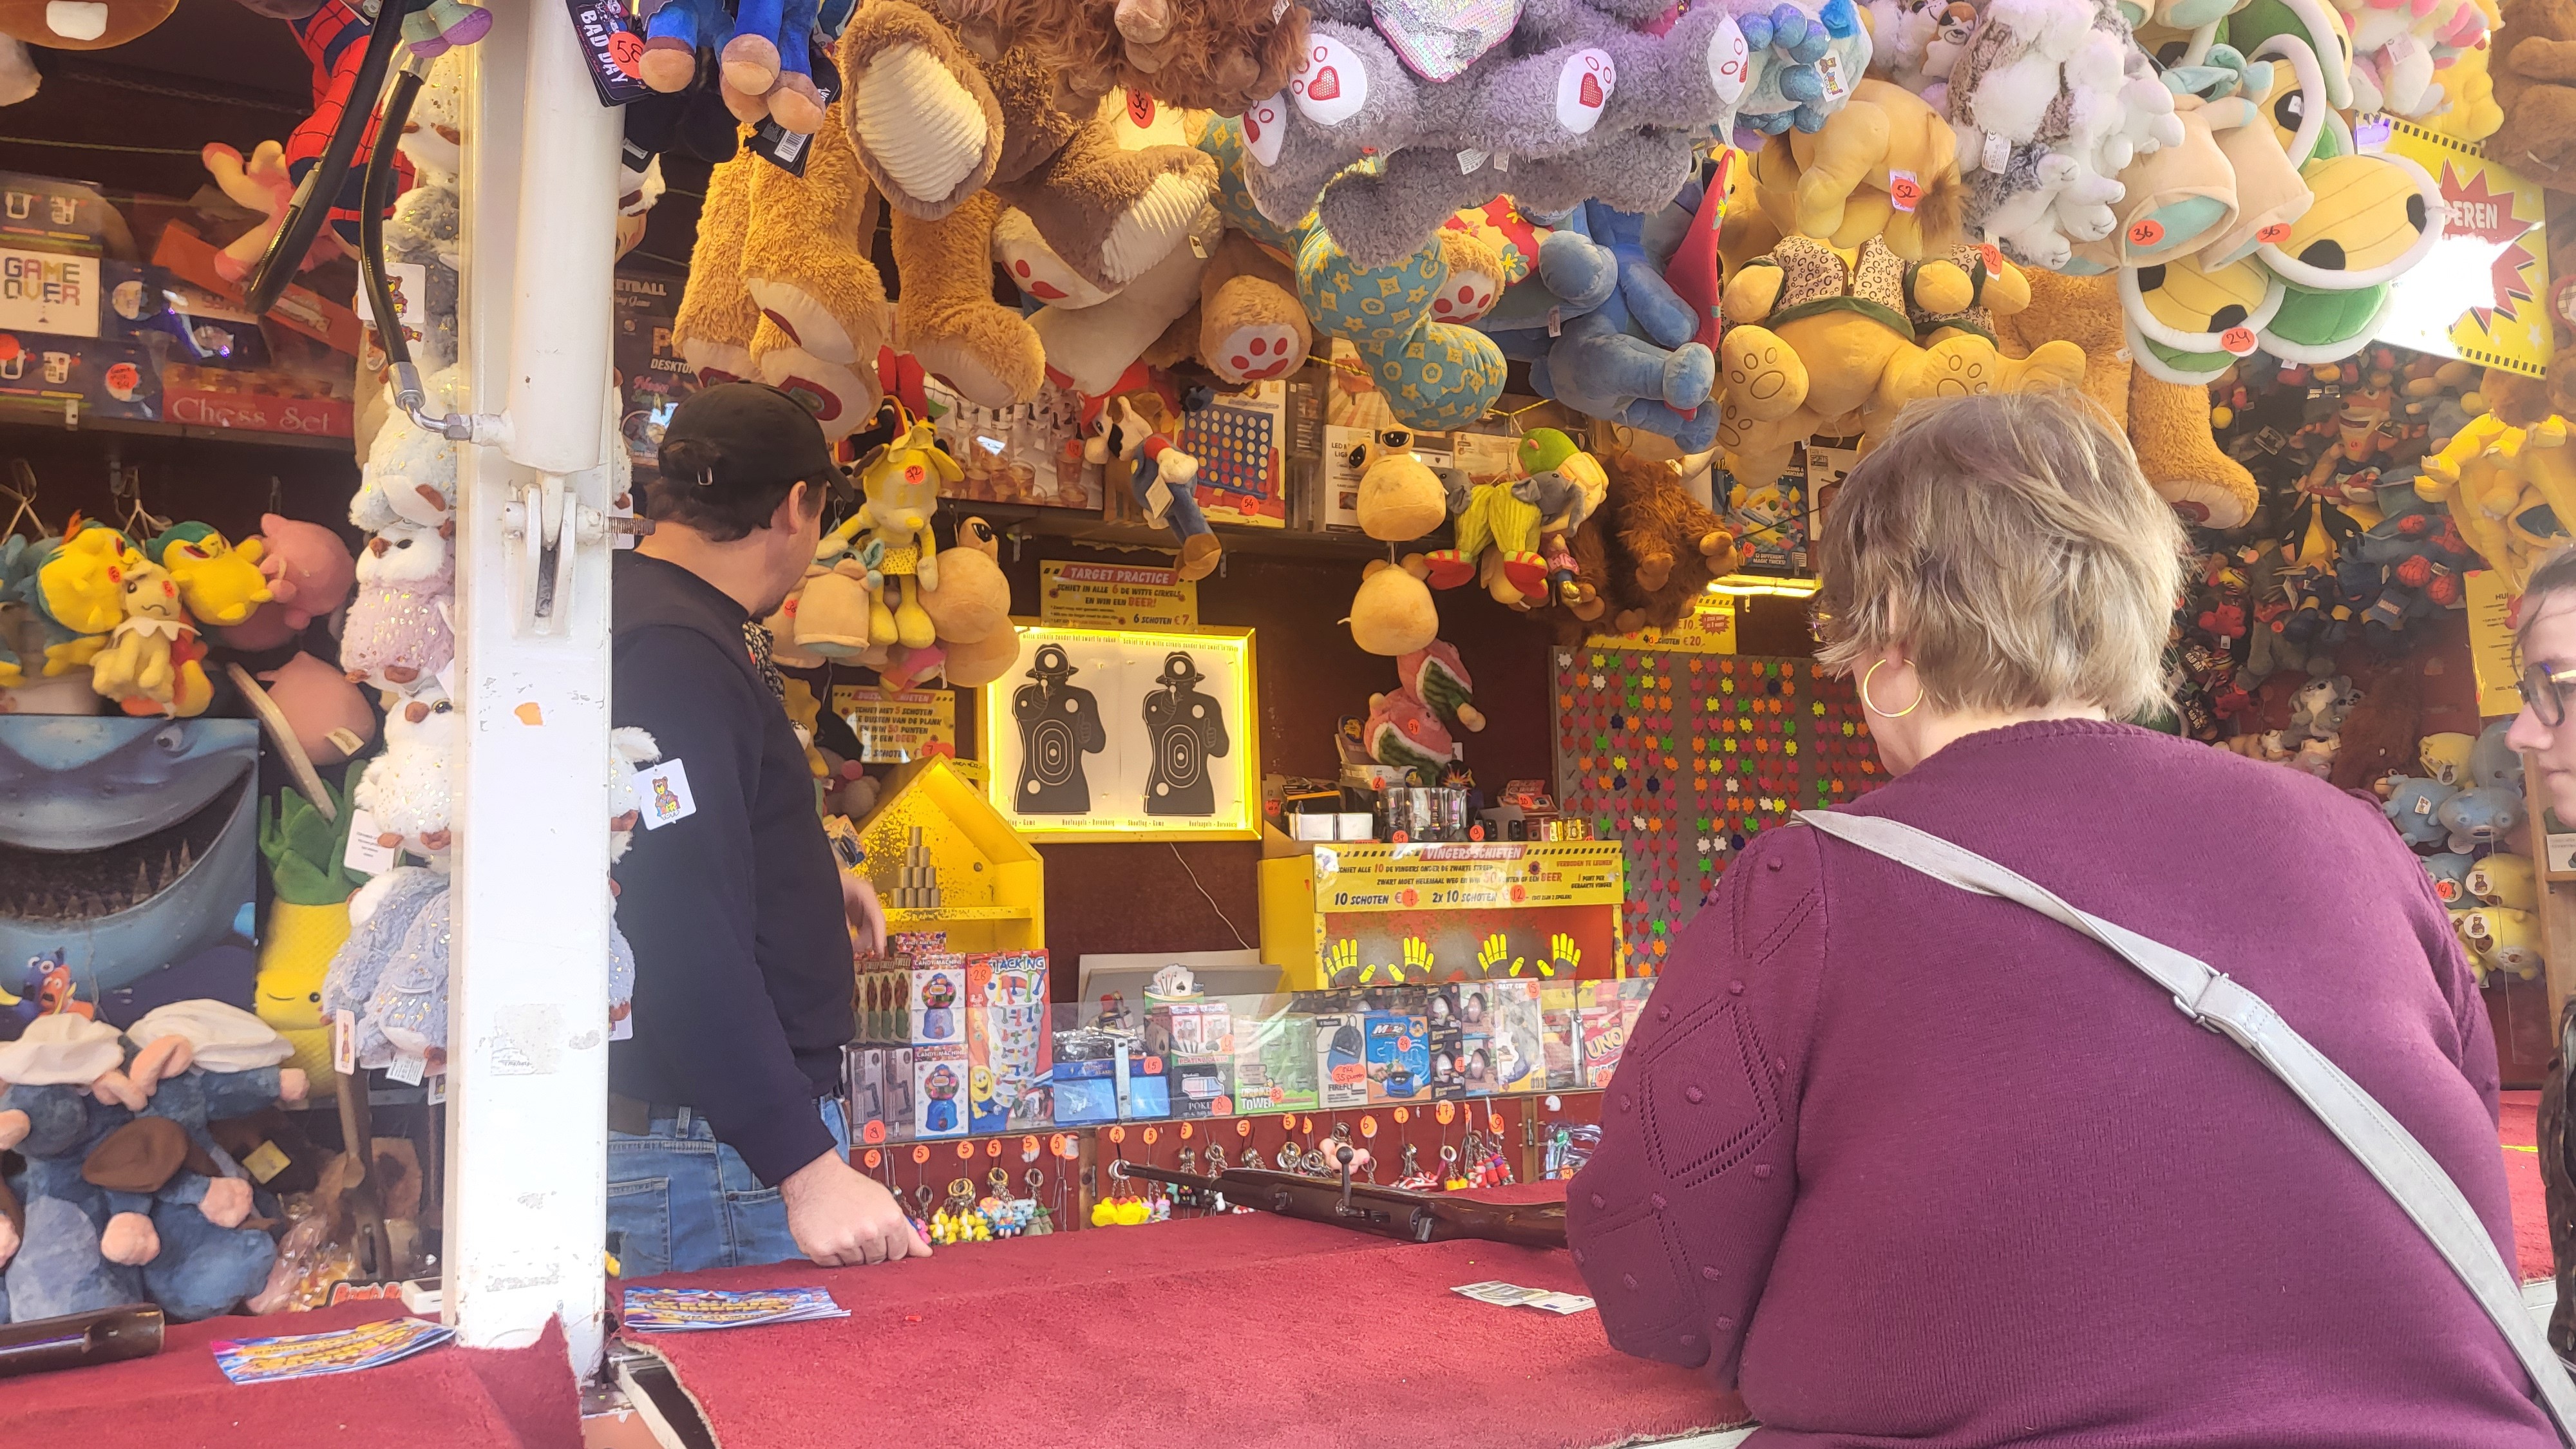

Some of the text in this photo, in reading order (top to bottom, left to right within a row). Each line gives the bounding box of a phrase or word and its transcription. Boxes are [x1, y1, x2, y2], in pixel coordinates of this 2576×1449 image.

[580, 10, 609, 46] BAD
[1897, 185, 1917, 198] 52
[2134, 225, 2154, 242] 36
[5, 257, 80, 284] GAME
[5, 279, 80, 307] OVER
[2226, 330, 2250, 345] 24
[172, 397, 329, 433] Chess Set
[1070, 567, 1170, 585] TARGET PRACTICE
[1057, 584, 1081, 592] SCHIET
[1092, 585, 1109, 594] ALLE
[1112, 583, 1119, 594] 6
[1085, 596, 1095, 605] EN
[1096, 597, 1112, 605] WIN
[1133, 613, 1140, 623] 6
[1141, 616, 1172, 625] SCHOTEN
[1374, 863, 1384, 873] 10
[1540, 872, 1562, 882] BEER
[1334, 892, 1349, 905] 10
[1350, 895, 1390, 905] SCHOTEN
[1446, 889, 1459, 903] 10
[1461, 892, 1497, 903] SCHOTEN
[1586, 1027, 1624, 1059] UNO
